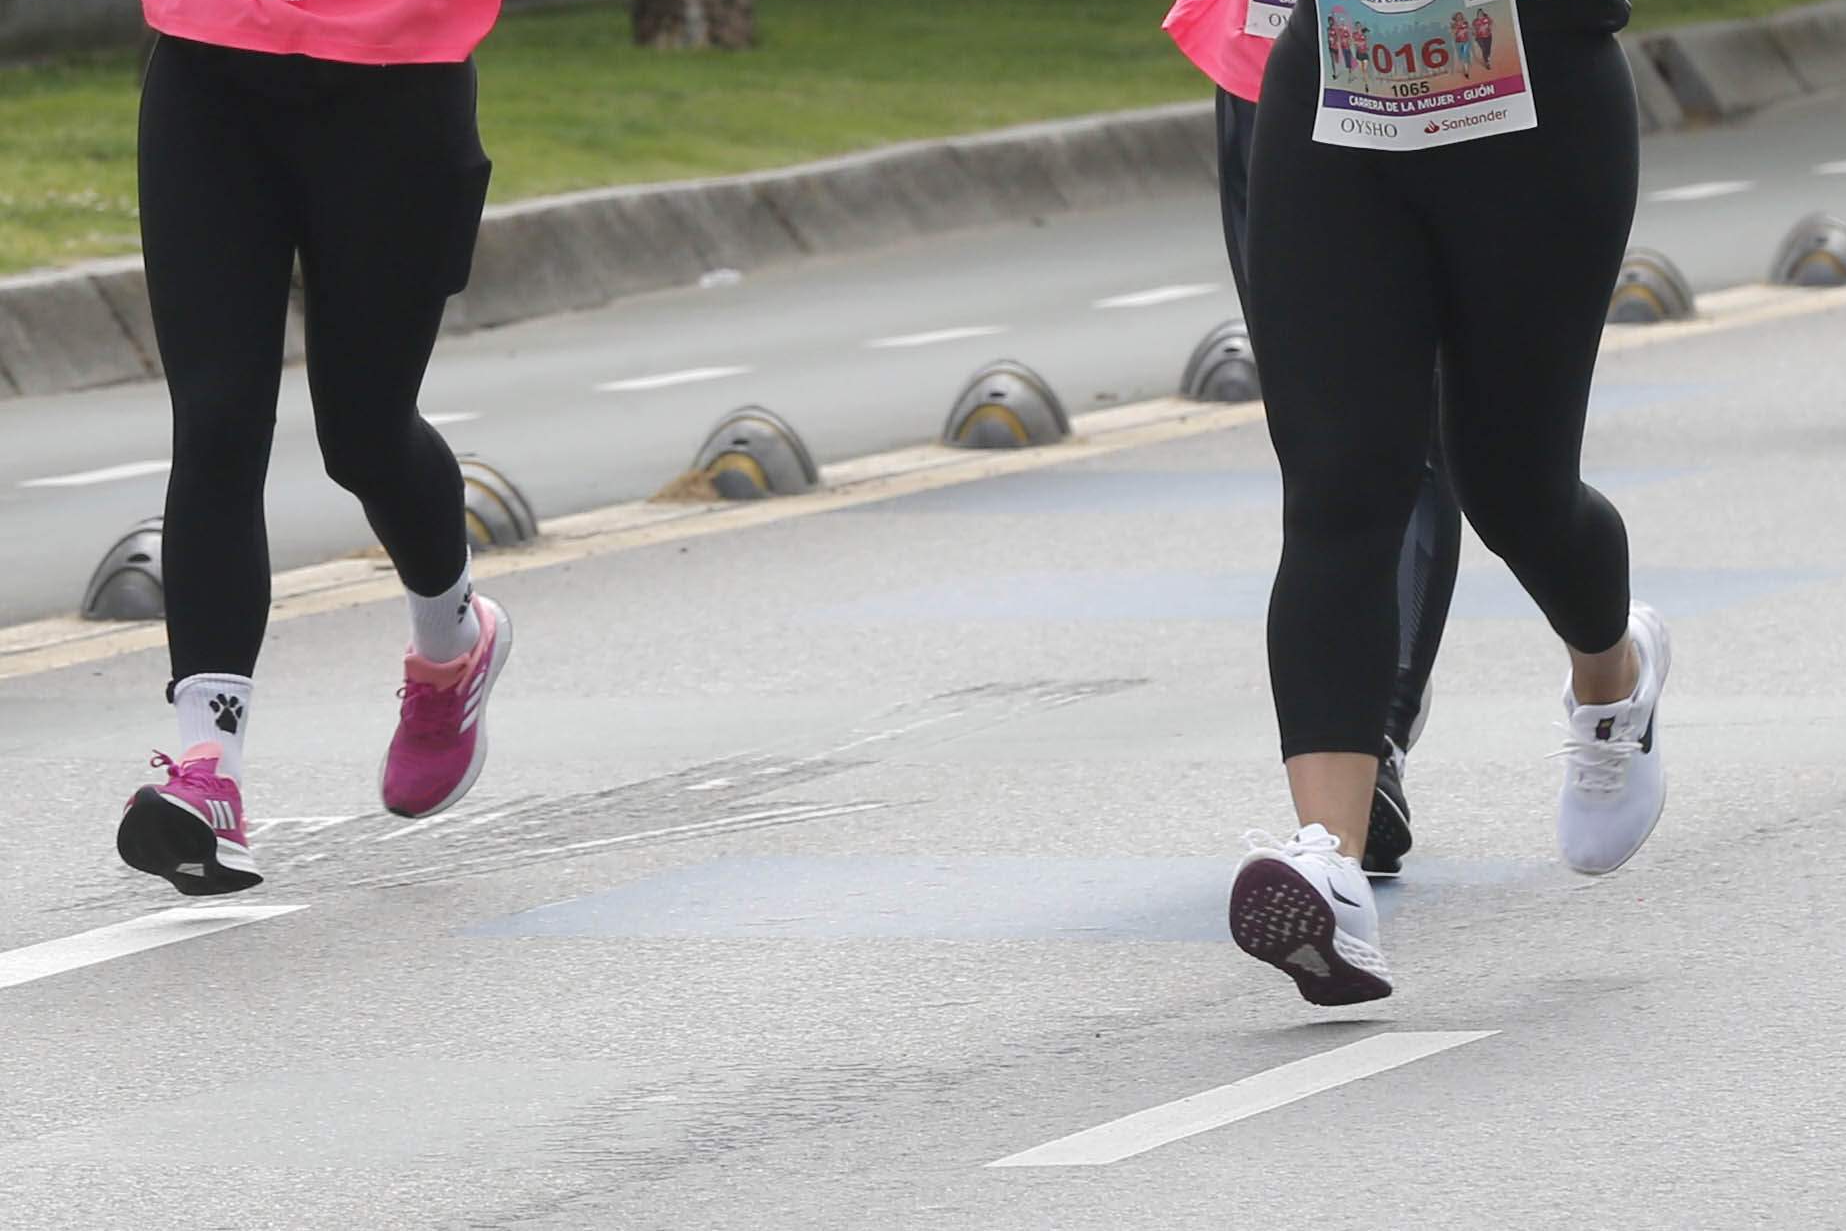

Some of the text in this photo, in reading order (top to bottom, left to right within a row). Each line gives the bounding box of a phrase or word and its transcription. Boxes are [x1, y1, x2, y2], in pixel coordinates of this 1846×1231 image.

[1371, 38, 1450, 75] 016
[1391, 81, 1430, 98] 1065
[1348, 95, 1384, 112] CARRERA
[1385, 101, 1399, 113] DE
[1401, 100, 1415, 112] LA
[1417, 95, 1455, 110] MUJER
[1341, 108, 1508, 139] OYSHO Santander
